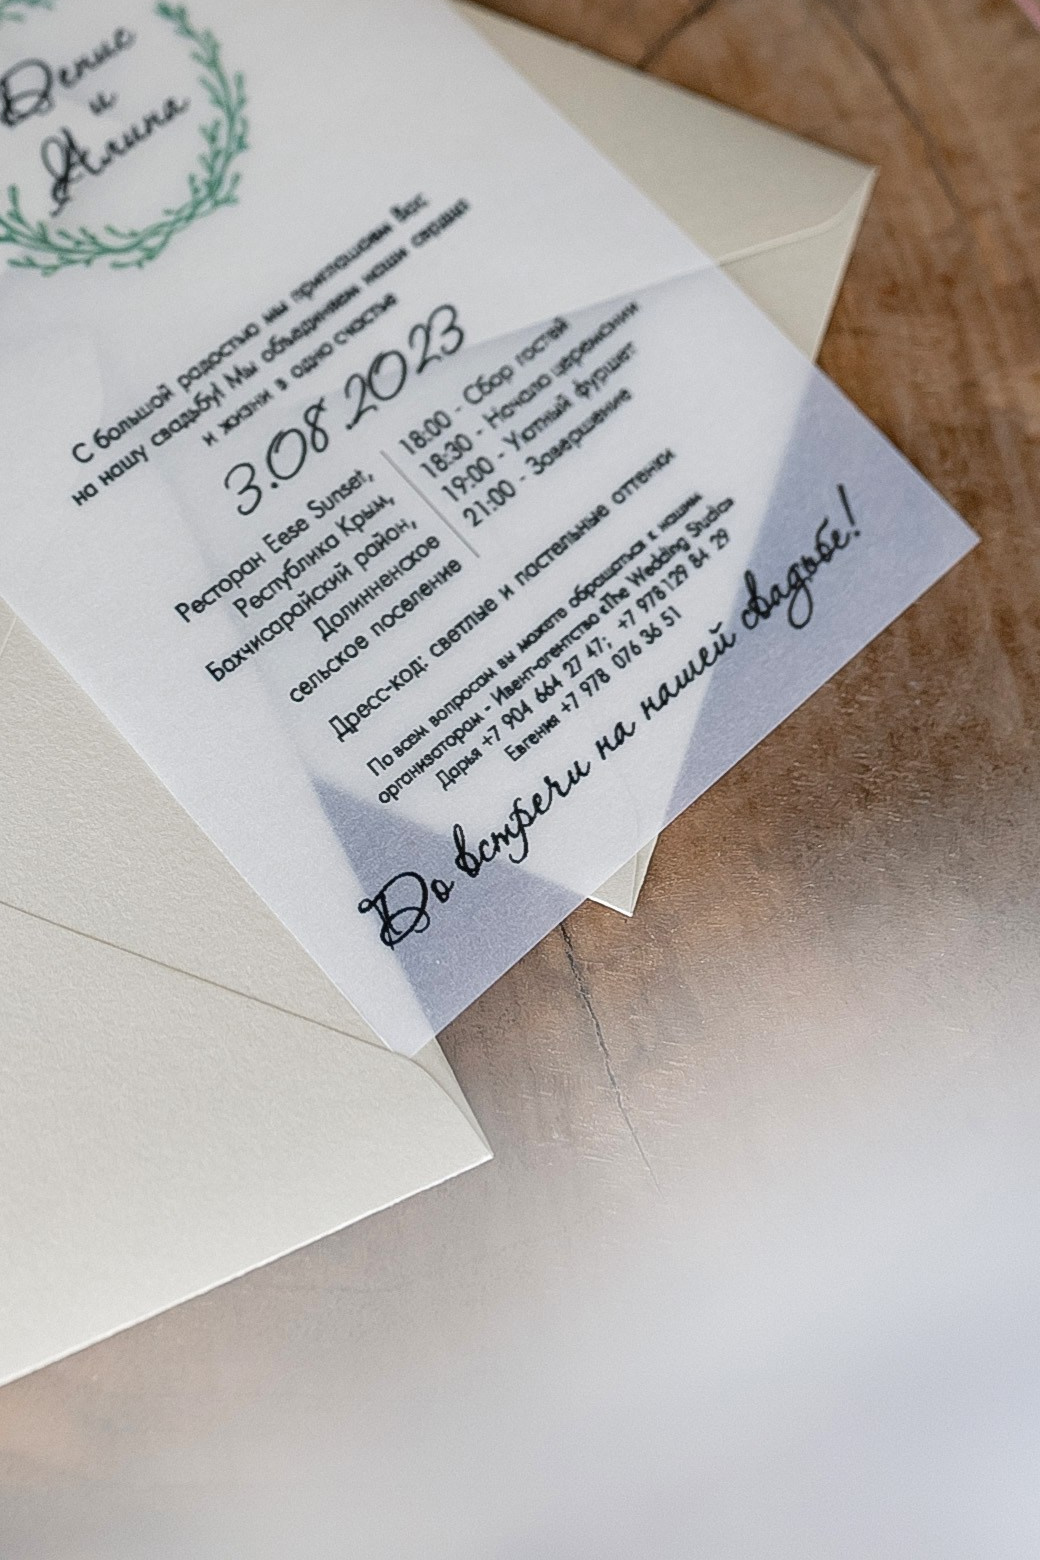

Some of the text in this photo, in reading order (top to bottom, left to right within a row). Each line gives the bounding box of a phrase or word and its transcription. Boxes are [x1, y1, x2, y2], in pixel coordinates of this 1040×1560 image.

[40, 97, 190, 219] Алина
[88, 92, 118, 117] и
[71, 442, 95, 464] С
[92, 383, 175, 450] большой
[176, 322, 262, 394] радостью
[261, 300, 290, 326] мы
[290, 221, 394, 303] приглашаем
[71, 198, 471, 507] на нашу свадьбу! Мы объединяем наши сердца
[201, 292, 399, 447] и жизни в одно счастье
[223, 303, 466, 517] 3.08.2023
[398, 409, 453, 456] 18:00
[462, 364, 515, 406] Сбор
[514, 316, 570, 367] гостей
[419, 433, 474, 479] 18:30
[481, 373, 553, 430] Начало
[550, 301, 640, 378] церемонии
[440, 455, 496, 503] 19:00
[501, 393, 574, 452] Уютный
[571, 340, 636, 400] фуршет
[462, 478, 517, 528] 21:00
[524, 387, 633, 476] Завершение
[173, 469, 375, 624] Ресторан Eese Sunset,
[204, 518, 418, 683] Бахчисарайский район,
[231, 495, 396, 619] Республика Крым,
[312, 535, 441, 643] Долинненское
[327, 448, 676, 743] Дресс-код: светлые и пастельные оттенки
[427, 667, 499, 728] вопросам
[496, 650, 518, 670] вы
[516, 607, 568, 654] можете
[567, 539, 648, 609] обращаться
[646, 530, 659, 542] к
[657, 492, 704, 533] нашим
[289, 558, 463, 703] сельское поселение
[378, 712, 486, 804] организаторам
[489, 612, 601, 707] Ивент-агентство
[598, 586, 631, 616] «The
[624, 536, 692, 588] Wedding
[684, 497, 735, 539] Studio»
[434, 747, 484, 792] Дарья
[481, 724, 502, 746] +7
[500, 698, 534, 731] 904
[533, 673, 564, 704] 664
[561, 653, 583, 679] 27
[584, 636, 613, 658] 47;
[617, 607, 637, 629] +7
[687, 547, 711, 570] 84
[708, 527, 731, 551] 29
[503, 605, 682, 762] Евгения +7 978 076 36 51
[357, 483, 862, 952] До встречи на нашей свадьбе!
